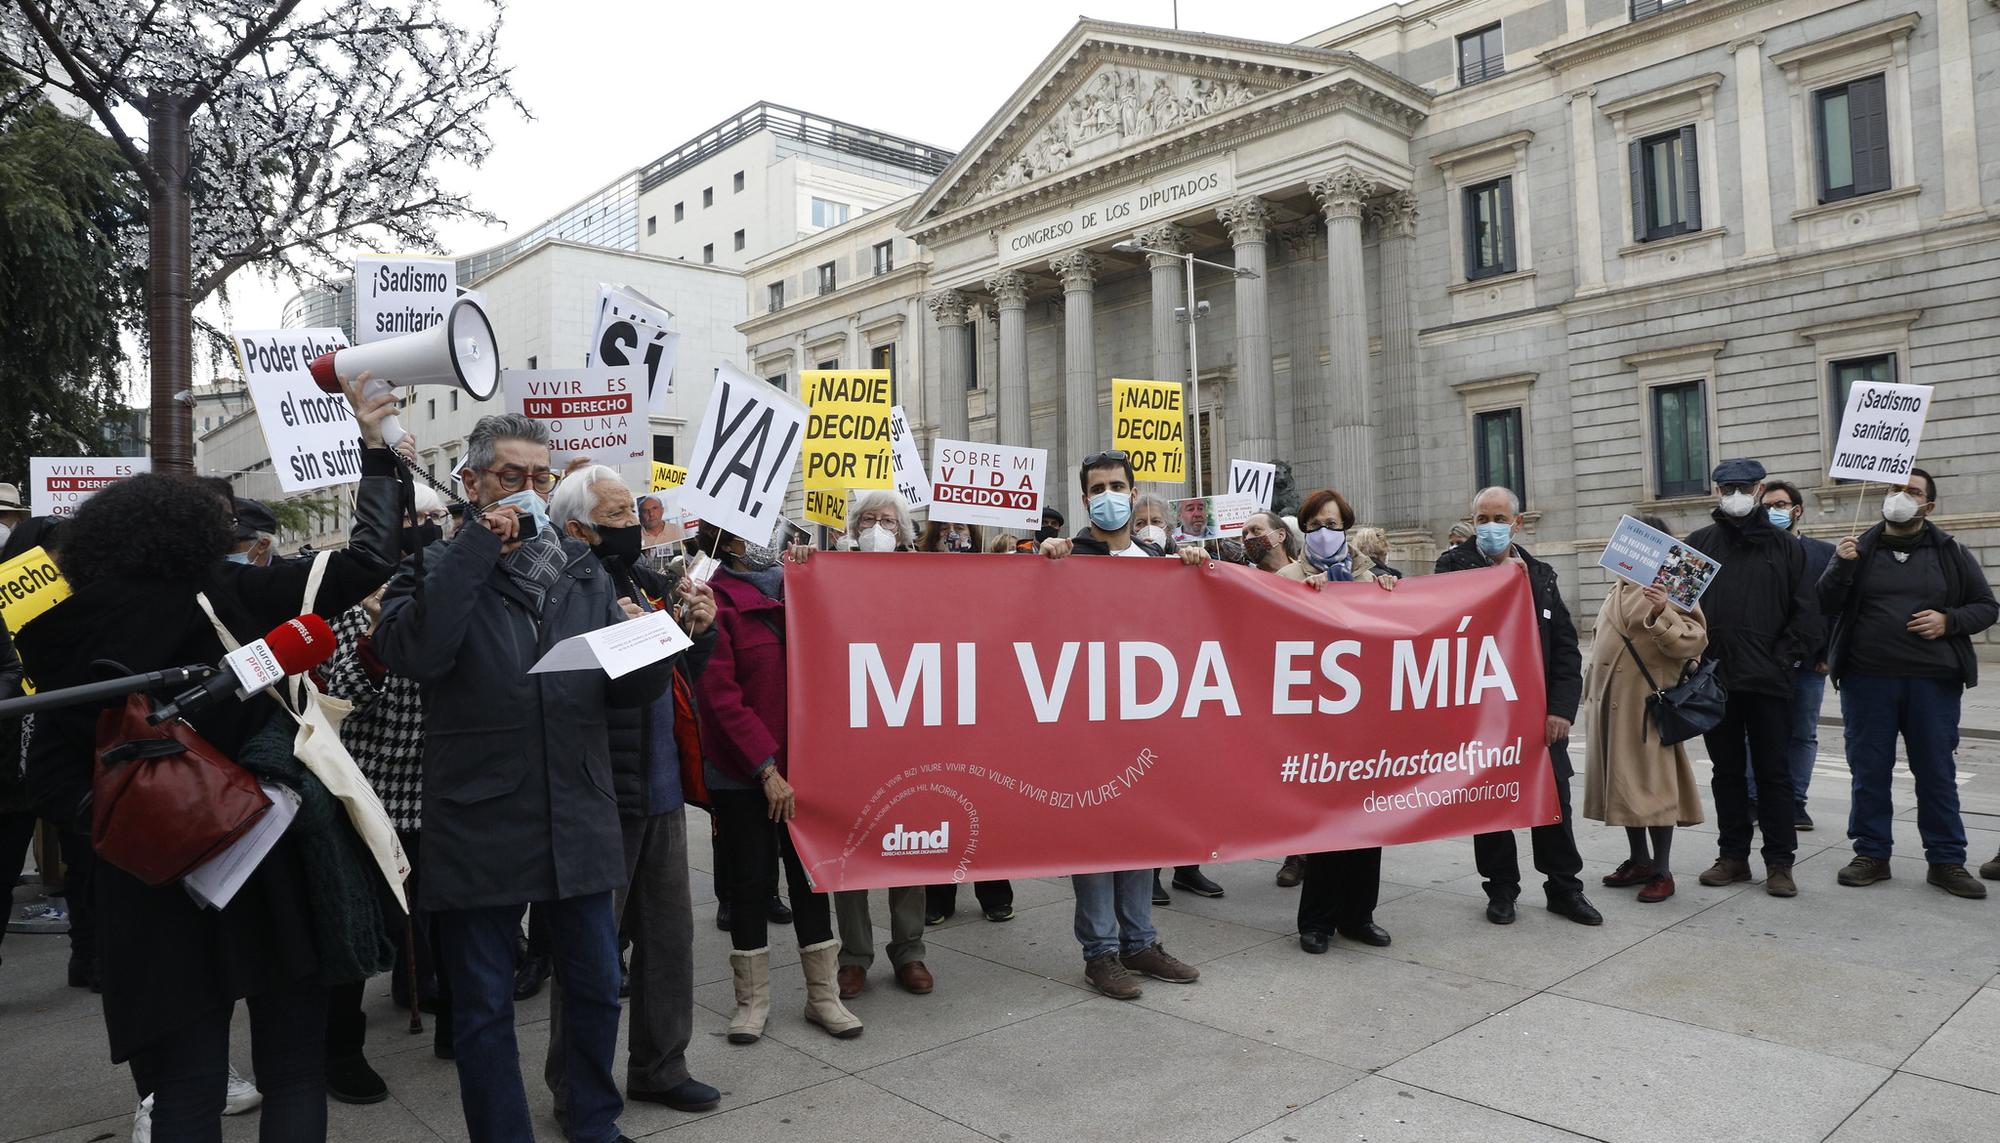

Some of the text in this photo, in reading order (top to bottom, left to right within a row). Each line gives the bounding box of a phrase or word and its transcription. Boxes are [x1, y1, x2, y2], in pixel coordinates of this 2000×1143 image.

[1011, 173, 1218, 251] CONGRESO DE LOS DIPUTADOS
[373, 264, 447, 298] ¡Sadismo
[242, 337, 299, 374] Poder
[528, 378, 626, 395] VIVIR ES
[809, 377, 888, 408] ¡NADIE
[1119, 387, 1181, 412] ¡NADIE
[1856, 388, 1921, 412] ¡Sadismo
[281, 391, 347, 427] el morir
[530, 399, 627, 415] UN DERECHO
[584, 416, 627, 431] UNA
[806, 414, 890, 442] DECIDA
[1117, 418, 1183, 442] DECIDA
[1852, 420, 1910, 447] sanitario,
[549, 432, 627, 451] BLIGACIÓN
[696, 381, 799, 518] YA!
[52, 465, 132, 476] VIVIR ES
[290, 440, 362, 482] sin sufri
[808, 448, 890, 480] POR TÍ!
[942, 448, 1034, 471] SOBRE MI
[1162, 447, 1182, 473] TÍ!
[1836, 452, 1915, 475] nunca más!
[52, 480, 70, 488] UN
[654, 467, 687, 485] ¡NADIE
[52, 492, 78, 502] NO
[806, 491, 845, 520] EN PAZ.
[939, 486, 1032, 508] DECIDO YO
[247, 656, 267, 683] press
[255, 644, 279, 677] europa
[848, 615, 1518, 728] MI VIDA ES MÍA
[1280, 737, 1522, 784] #libreshastaelfinal
[904, 768, 918, 778] BIZI
[920, 762, 942, 773] VIURE
[945, 762, 966, 772] VIVIR
[969, 764, 986, 777] BIZI
[988, 769, 1017, 790] VIURE
[1019, 780, 1048, 803] VIVIR
[1049, 790, 1074, 809] BIZI
[1076, 779, 1121, 808] VIURE
[1117, 747, 1159, 788] VIVIR
[917, 784, 928, 792] HIL
[930, 783, 958, 800] MORIR
[1362, 780, 1520, 813] derechoamorir.org
[956, 793, 979, 836] MORRER
[882, 821, 949, 851] dmd
[964, 838, 978, 855] HIL
